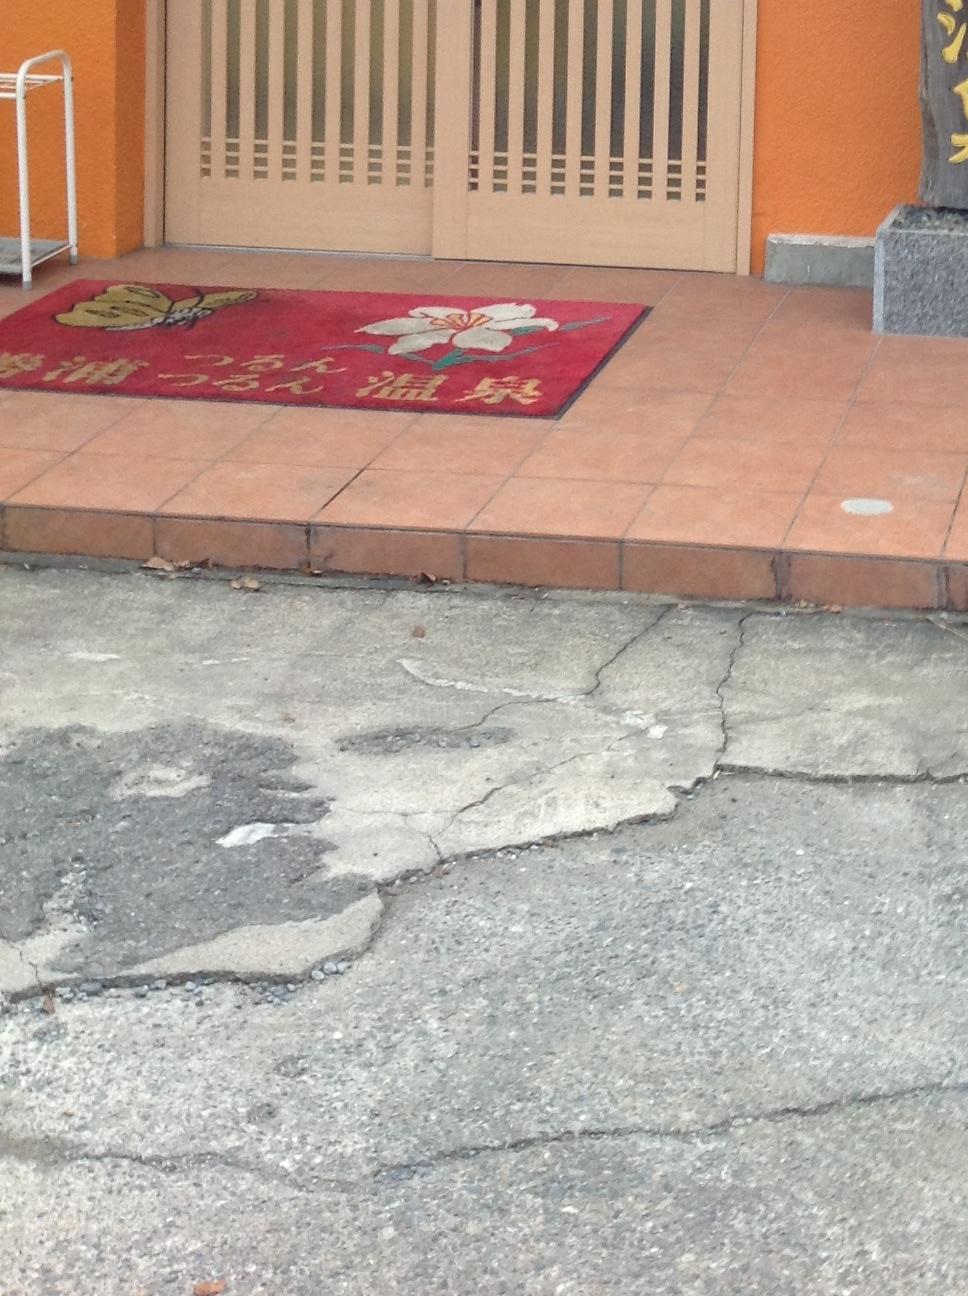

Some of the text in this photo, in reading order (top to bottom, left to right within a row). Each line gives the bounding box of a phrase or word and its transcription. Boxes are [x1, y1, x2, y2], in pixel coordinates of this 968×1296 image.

[184, 354, 346, 374] つるん
[157, 373, 325, 395] つるん
[355, 370, 544, 405] 温泉
